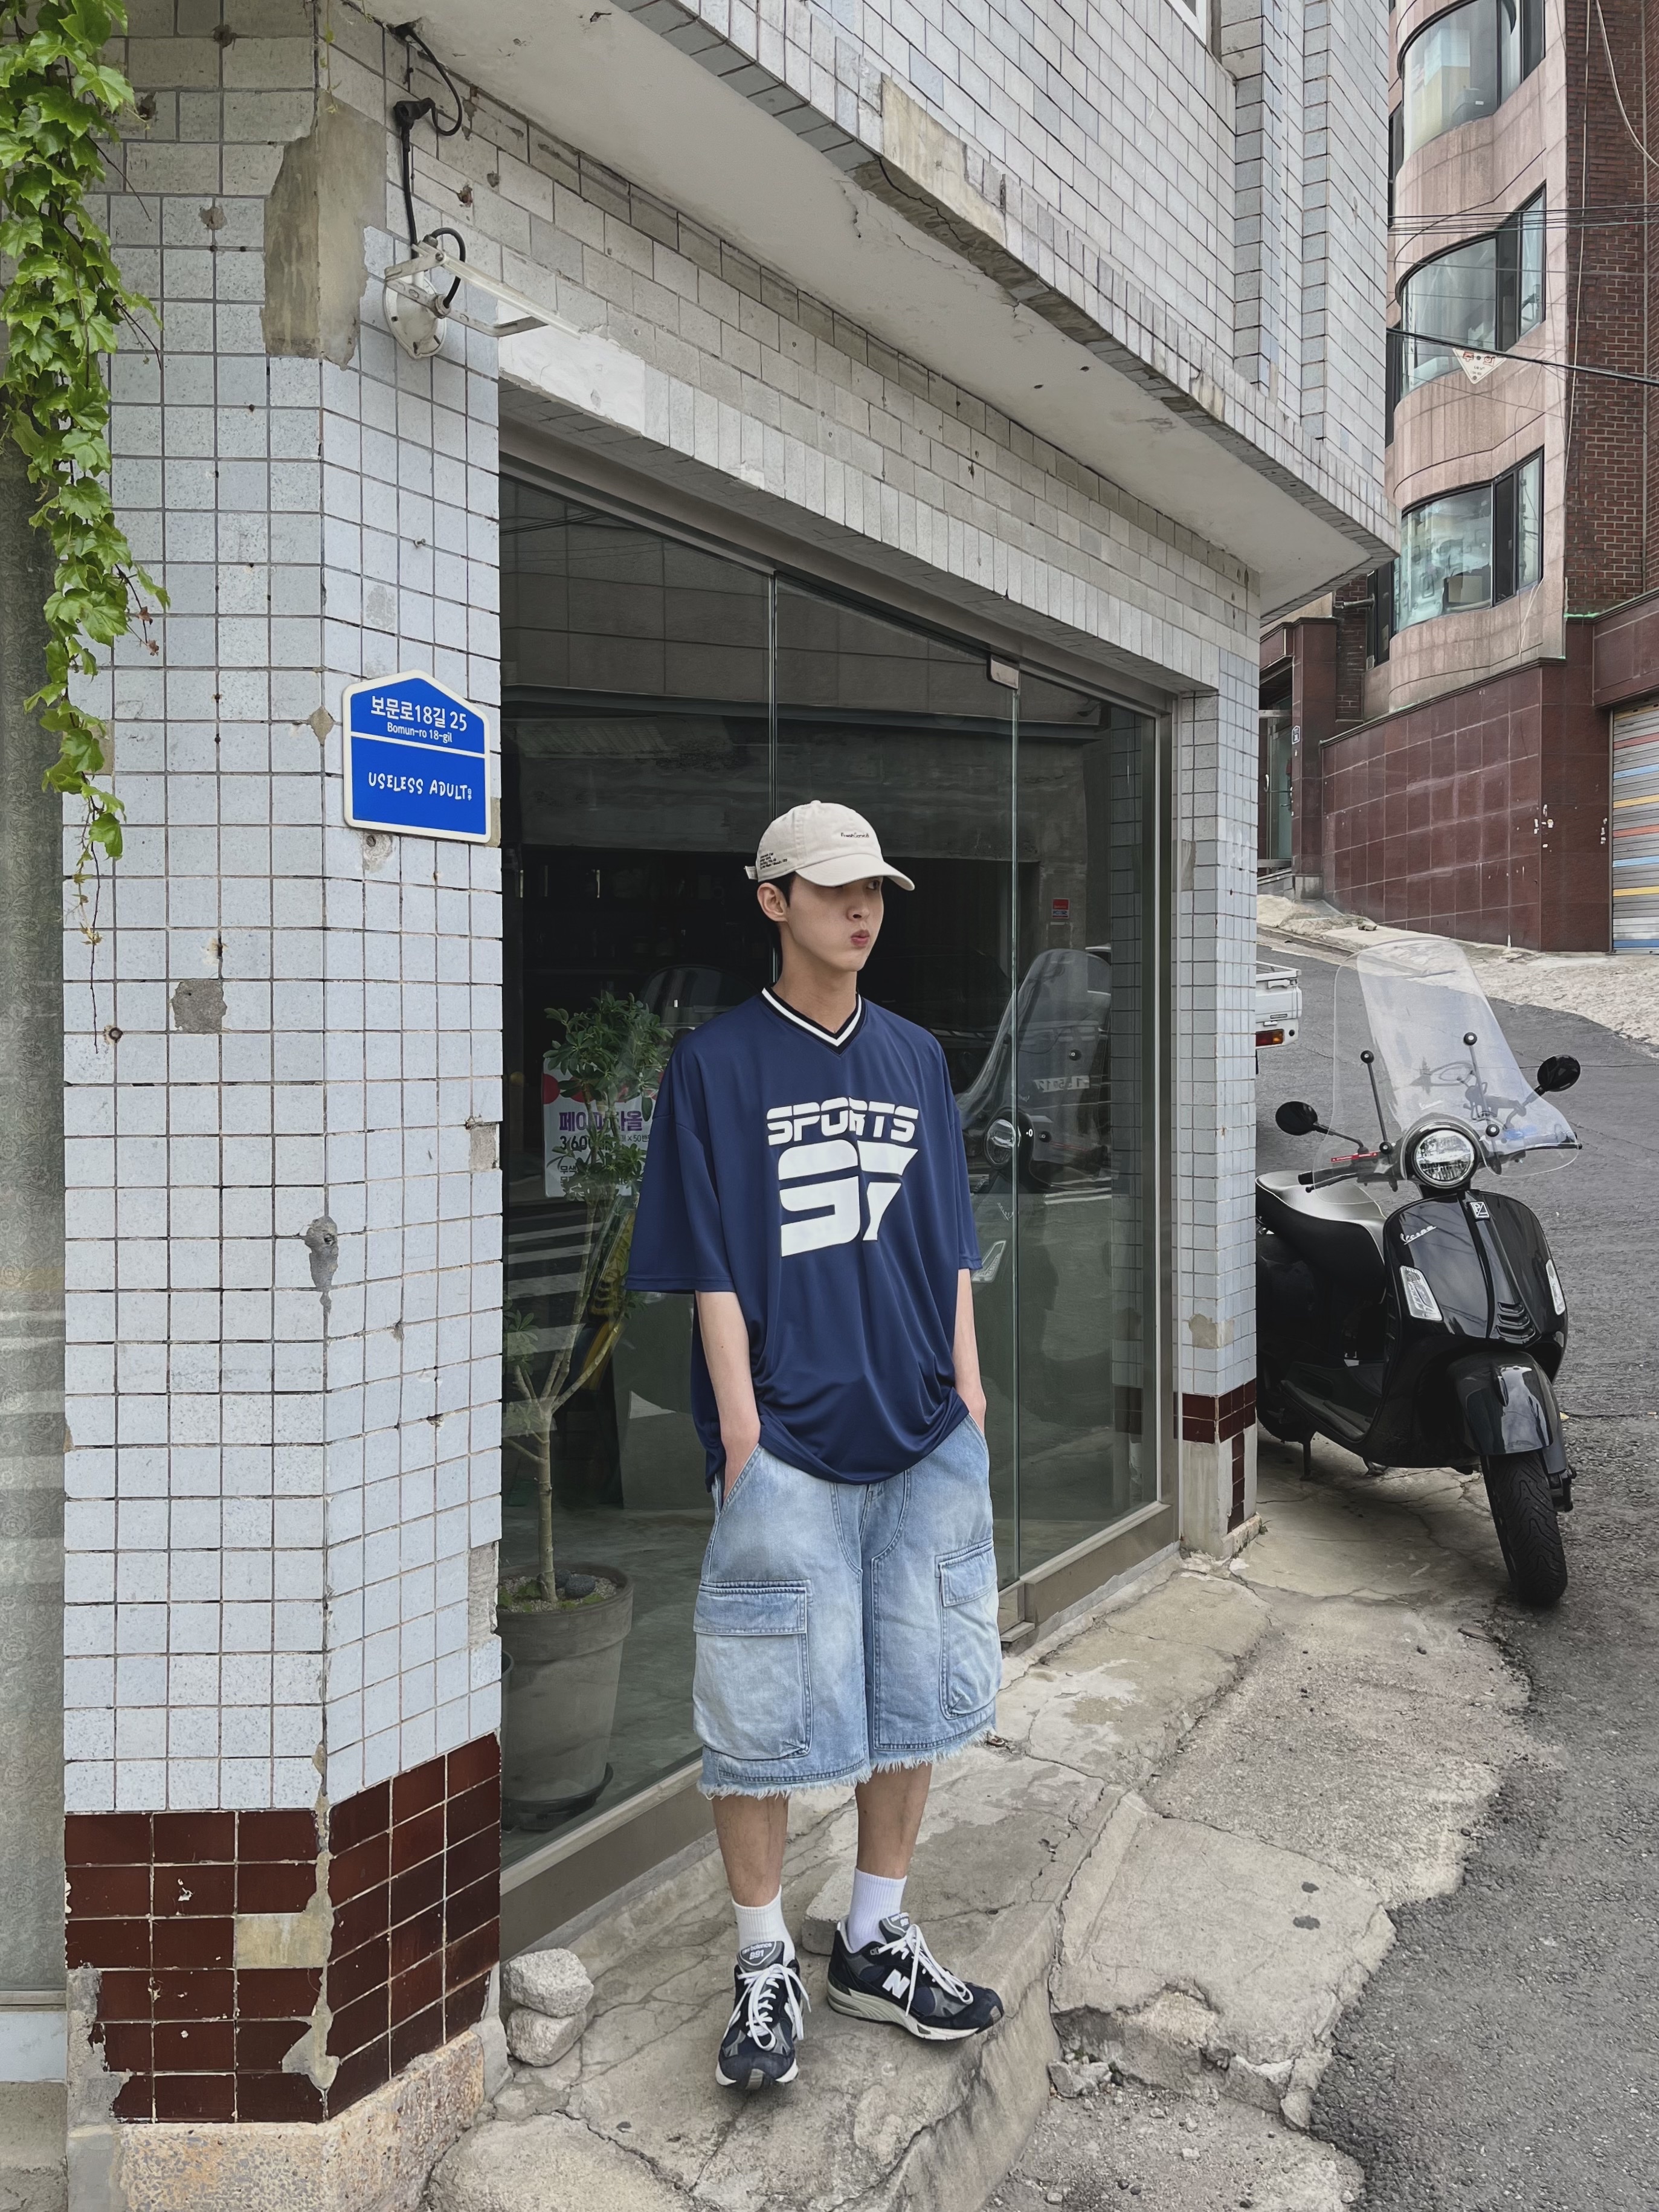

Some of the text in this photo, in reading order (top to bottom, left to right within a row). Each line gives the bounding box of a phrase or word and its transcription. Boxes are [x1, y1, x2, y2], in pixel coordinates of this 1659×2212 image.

[370, 695, 467, 732] 보문로18길 25
[387, 722, 453, 744] Bomun-ro 18-gil
[368, 772, 468, 800] USELESS ADULT
[766, 1097, 919, 1146] SPORTS
[1400, 1225, 1437, 1245] Vespa
[749, 1949, 764, 1960] 991
[750, 1943, 773, 1951] balance
